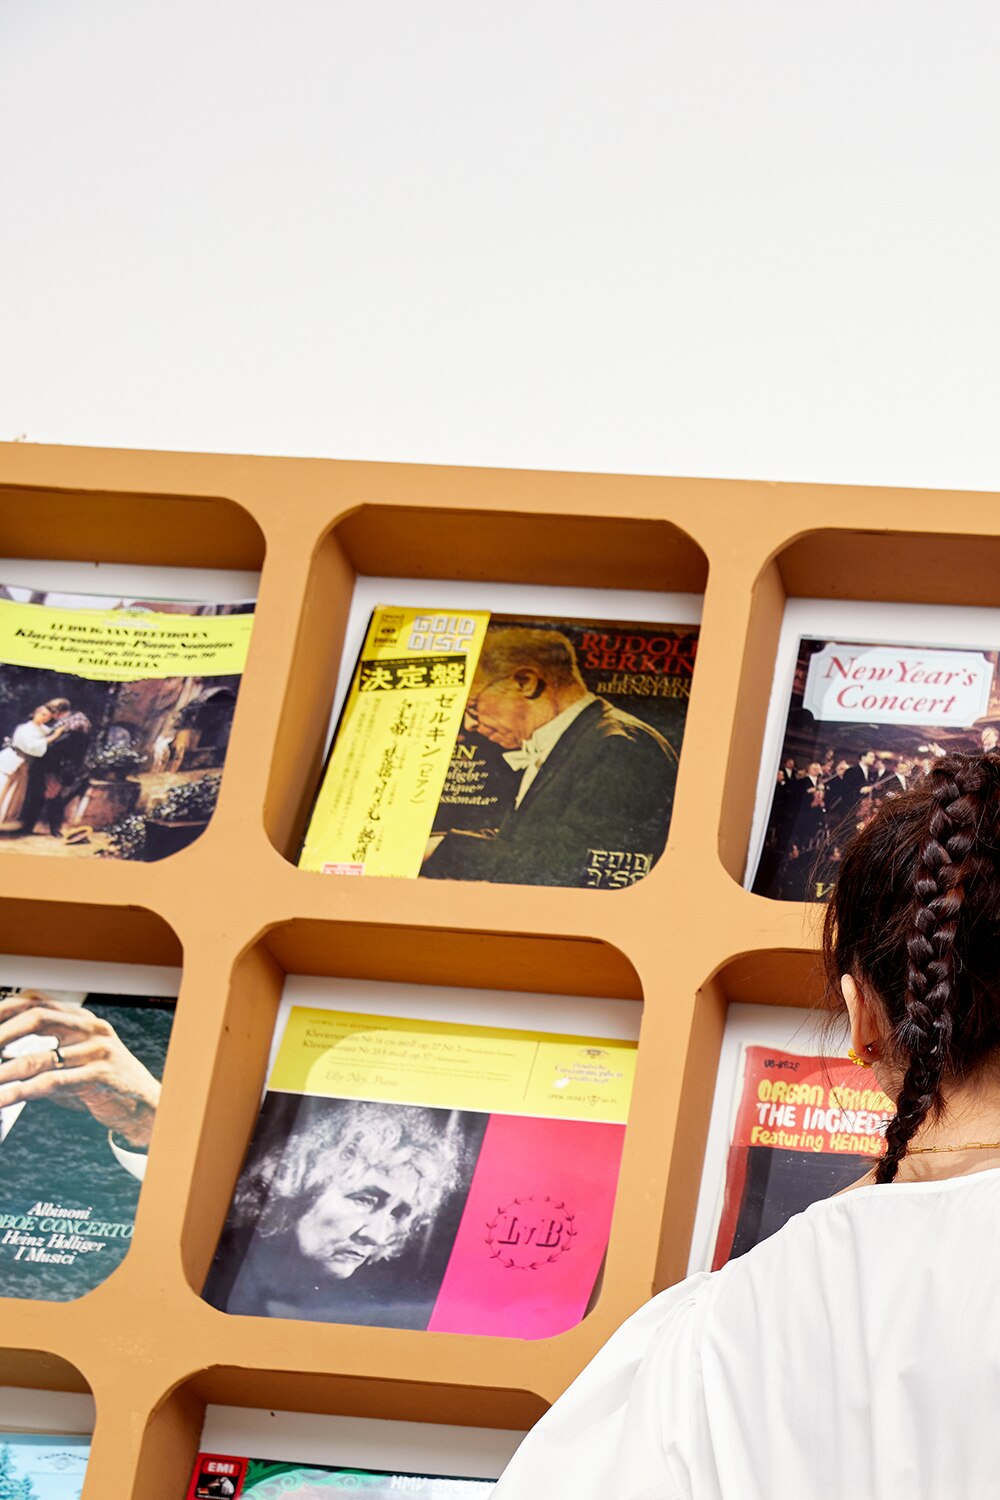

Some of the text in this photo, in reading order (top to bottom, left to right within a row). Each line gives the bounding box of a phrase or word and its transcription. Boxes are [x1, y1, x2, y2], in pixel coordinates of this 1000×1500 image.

[407, 632, 473, 653] DISC
[360, 662, 465, 692] 決定盤
[822, 656, 894, 682] New
[836, 684, 959, 714] Concert
[757, 1079, 898, 1113] ORGAN GRIND
[756, 1102, 796, 1127] THE
[751, 1126, 825, 1153] Featuring
[27, 1201, 93, 1220] Albinoni
[39, 1217, 136, 1239] CONCERTO
[2, 1229, 107, 1253] Heinz Holliger
[14, 1246, 78, 1265] I Musici
[207, 1461, 235, 1475] EMI
[390, 1475, 428, 1490] HMV
